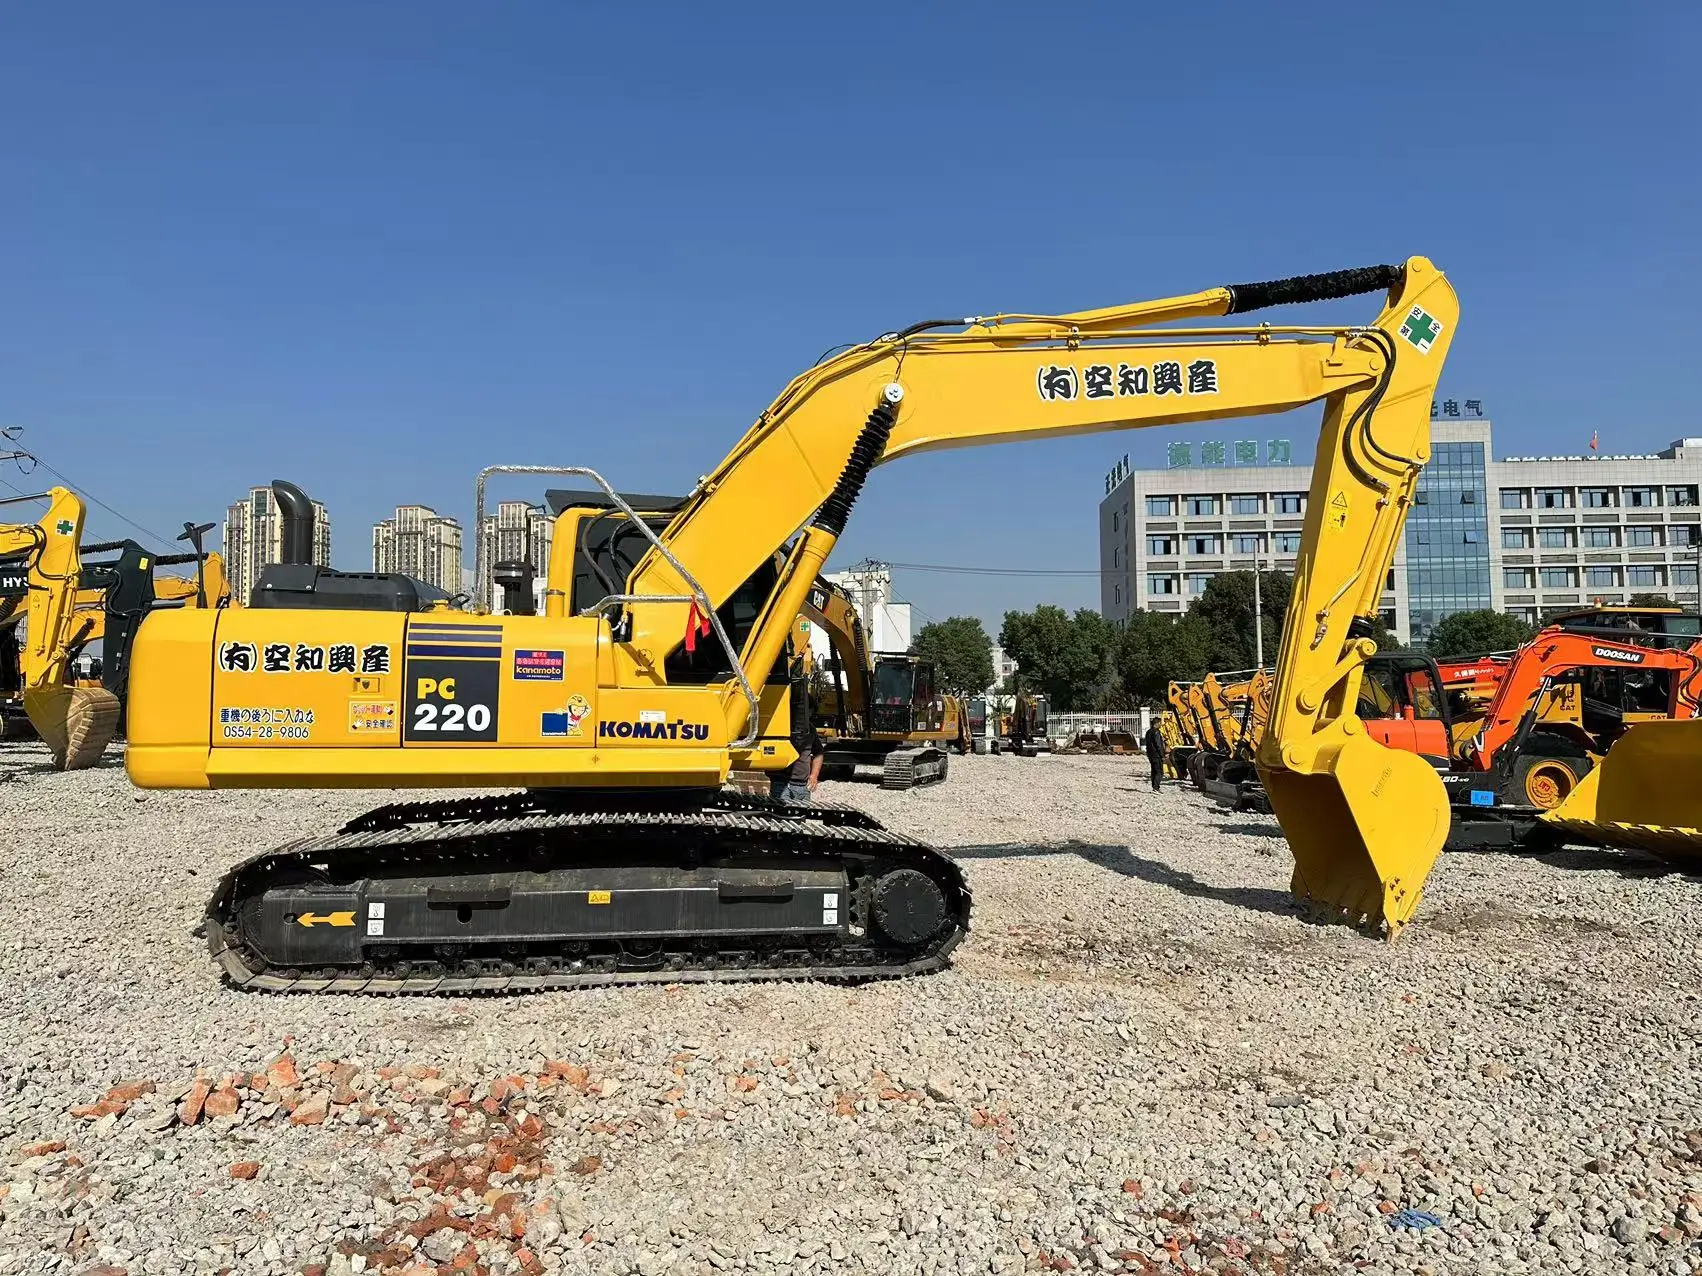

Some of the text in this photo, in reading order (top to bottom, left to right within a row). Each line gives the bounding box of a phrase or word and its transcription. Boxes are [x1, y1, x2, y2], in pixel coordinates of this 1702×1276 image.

[1595, 647, 1641, 662] DOOSAN
[516, 665, 561, 675] kanamoto
[417, 677, 455, 700] PC
[413, 703, 491, 732] 220
[599, 719, 708, 741] KOMATSU
